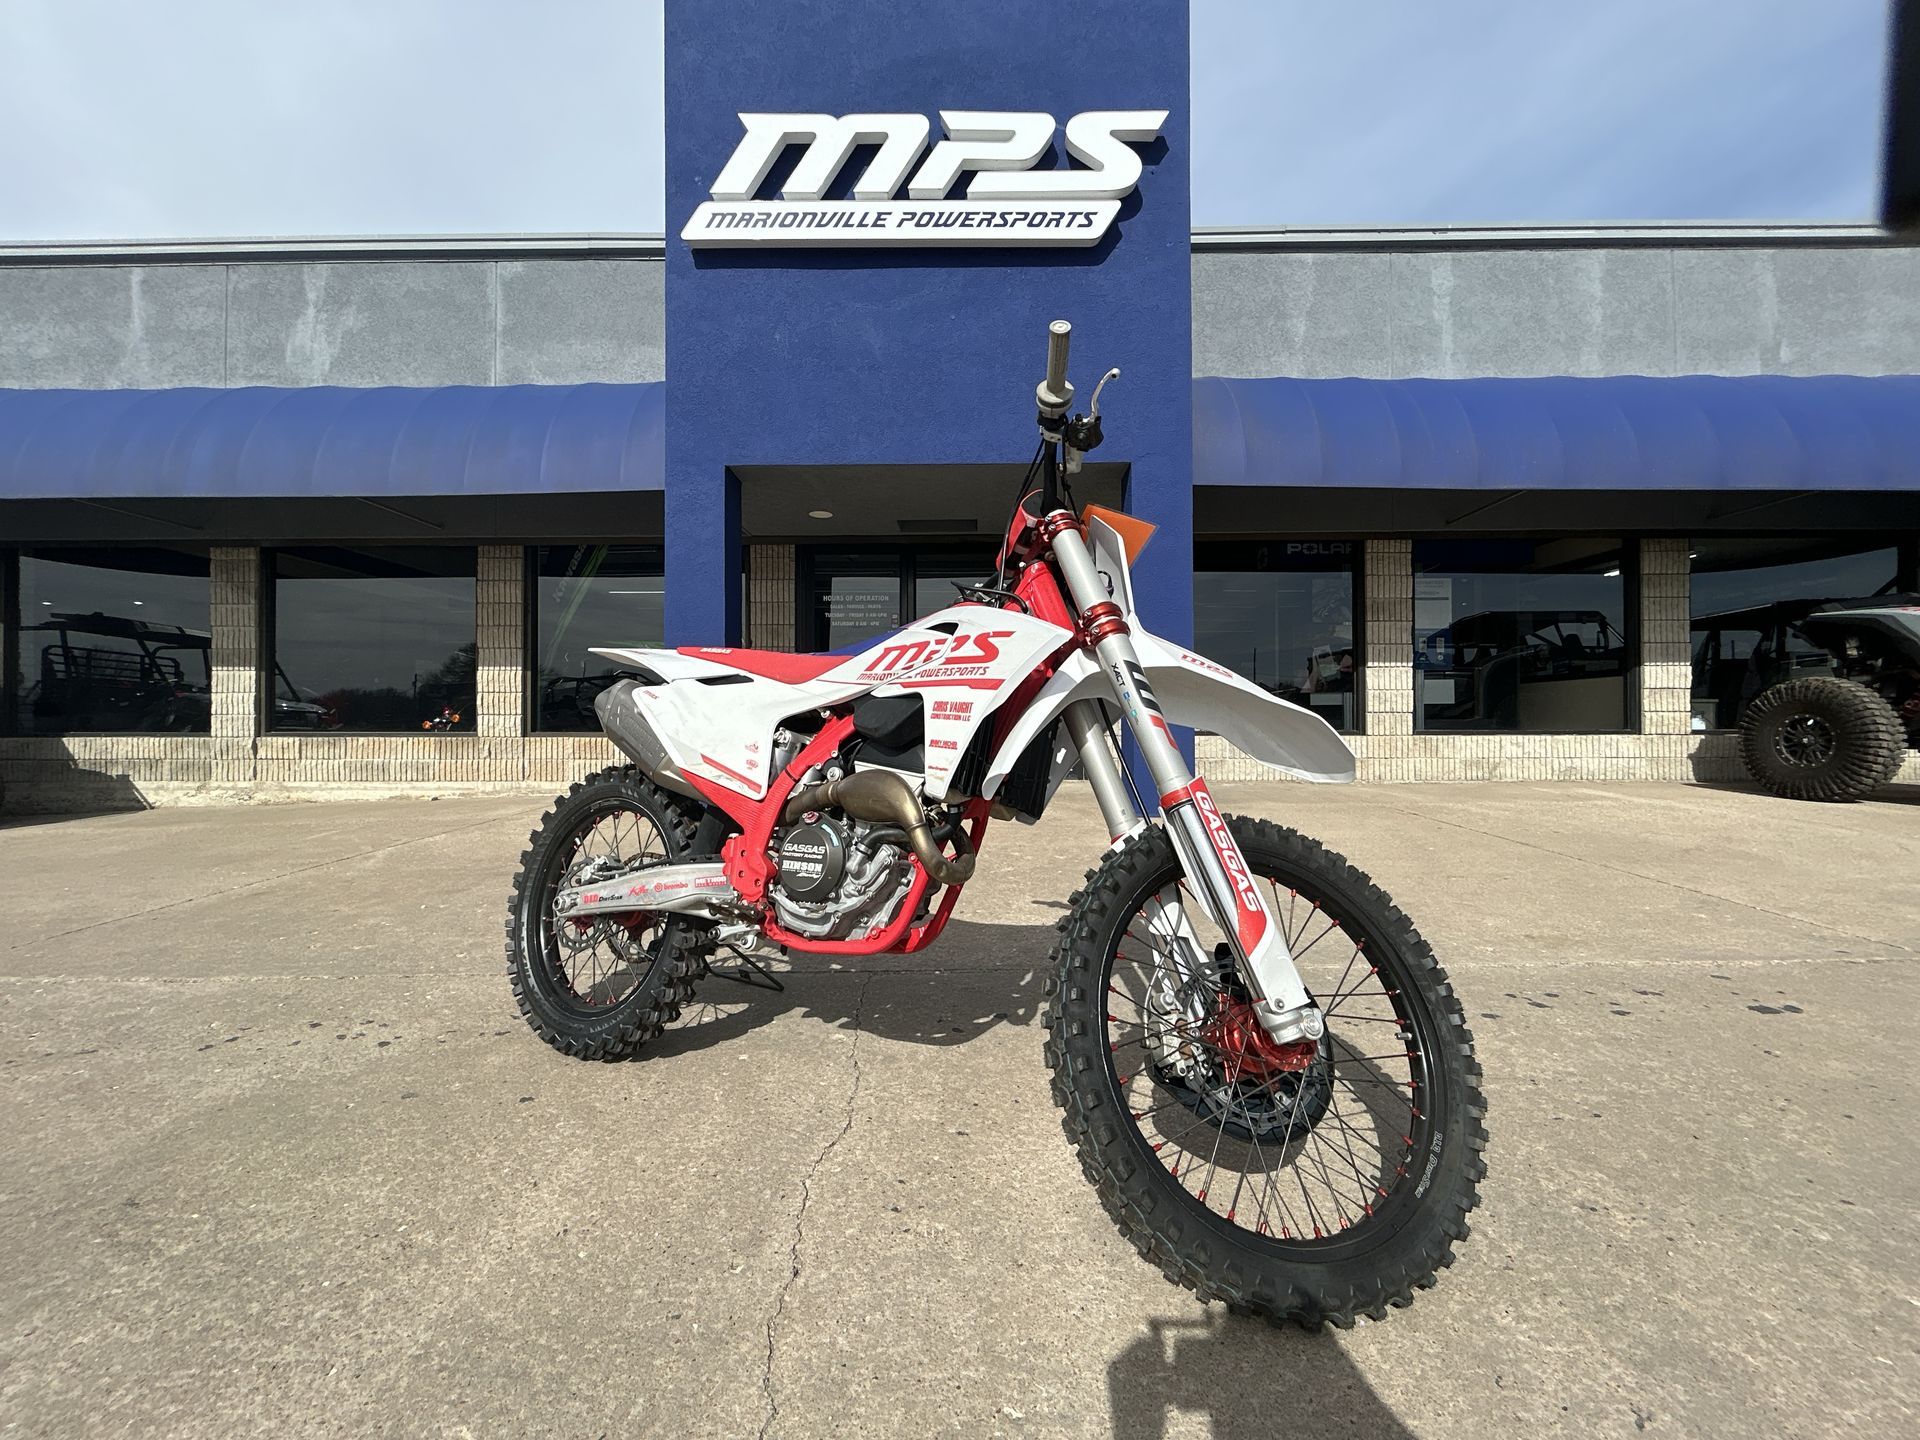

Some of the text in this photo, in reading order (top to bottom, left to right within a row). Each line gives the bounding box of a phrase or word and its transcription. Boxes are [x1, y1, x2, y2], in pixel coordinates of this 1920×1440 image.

[710, 110, 1169, 200] MPS
[705, 211, 1098, 229] MARIONVILLE POWERSPORTS
[864, 630, 1016, 671] MPS
[914, 666, 990, 679] POWERSPORTS
[1111, 663, 1126, 687] XACT
[784, 843, 826, 855] GASGAS
[1195, 791, 1261, 912] GASGAS
[782, 860, 823, 873] HINSON
[663, 882, 689, 891] brembo
